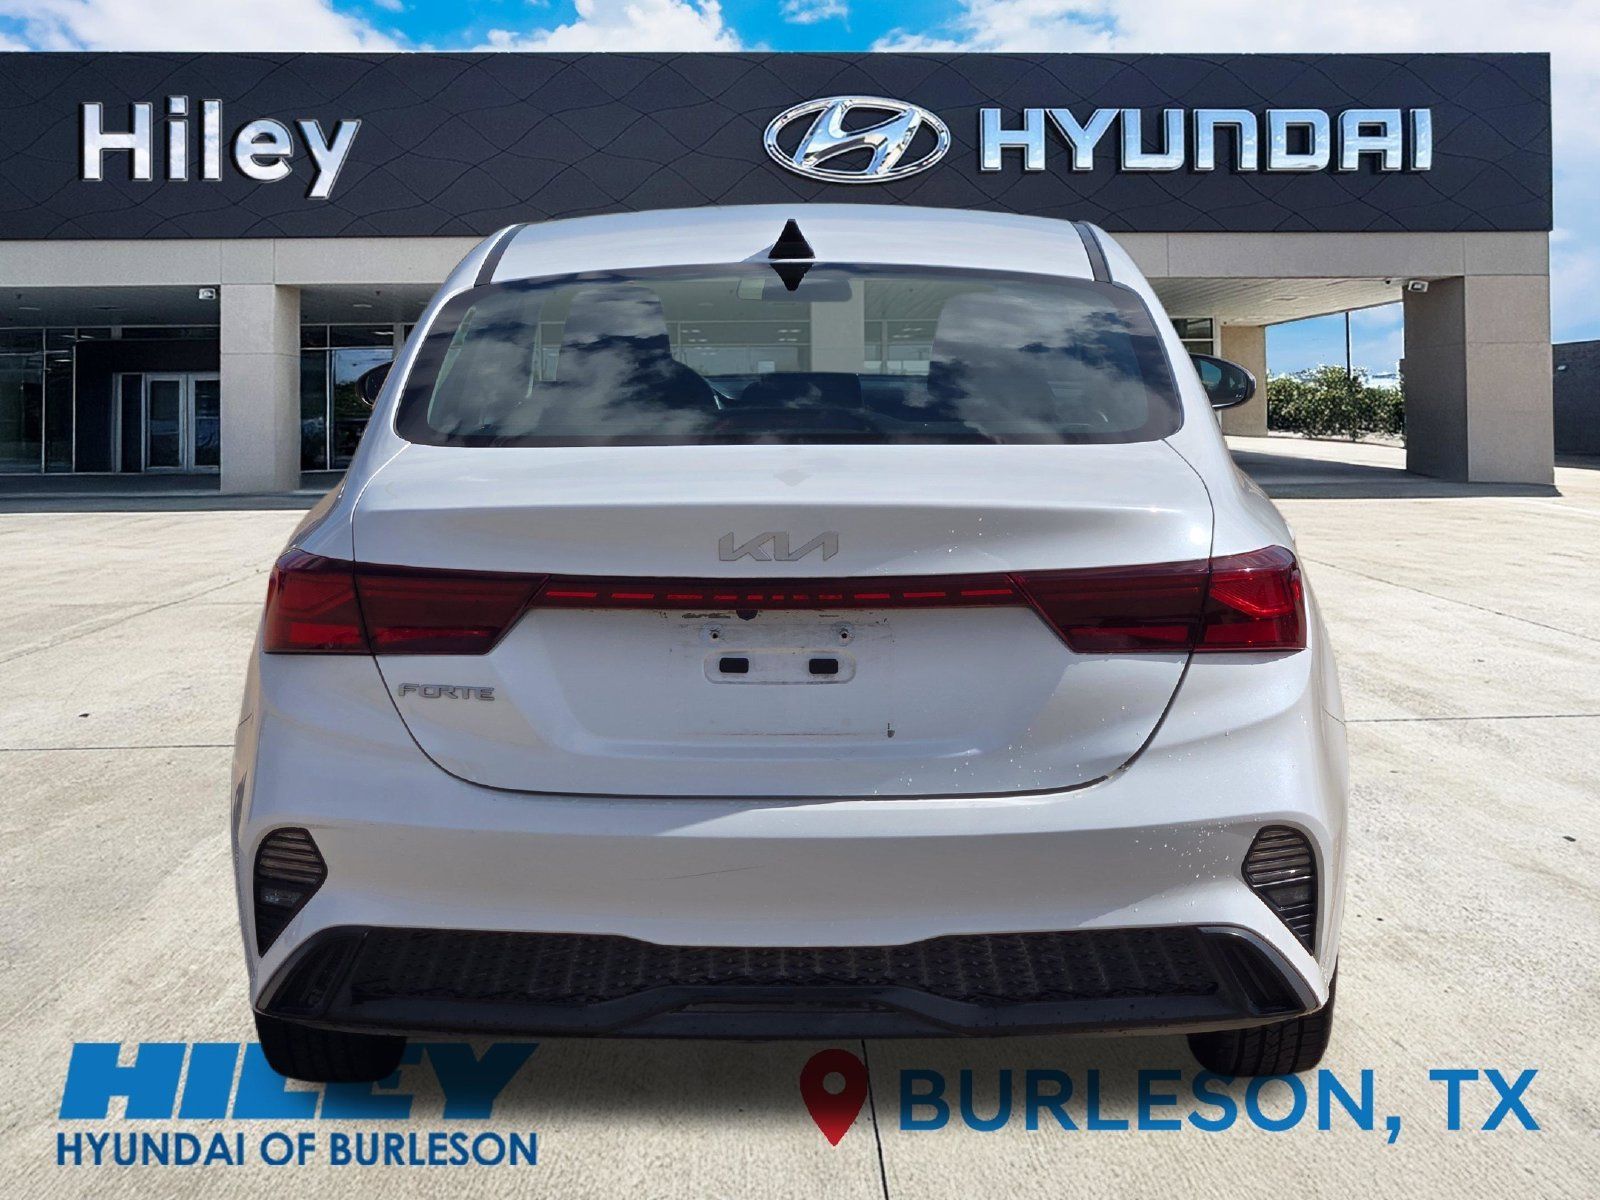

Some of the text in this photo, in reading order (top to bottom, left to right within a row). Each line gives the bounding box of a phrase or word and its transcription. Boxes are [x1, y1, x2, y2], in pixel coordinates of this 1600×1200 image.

[80, 95, 362, 199] Hiley
[979, 108, 1432, 172] HYUNDAI
[719, 531, 839, 562] KIA
[398, 682, 496, 702] FORTE
